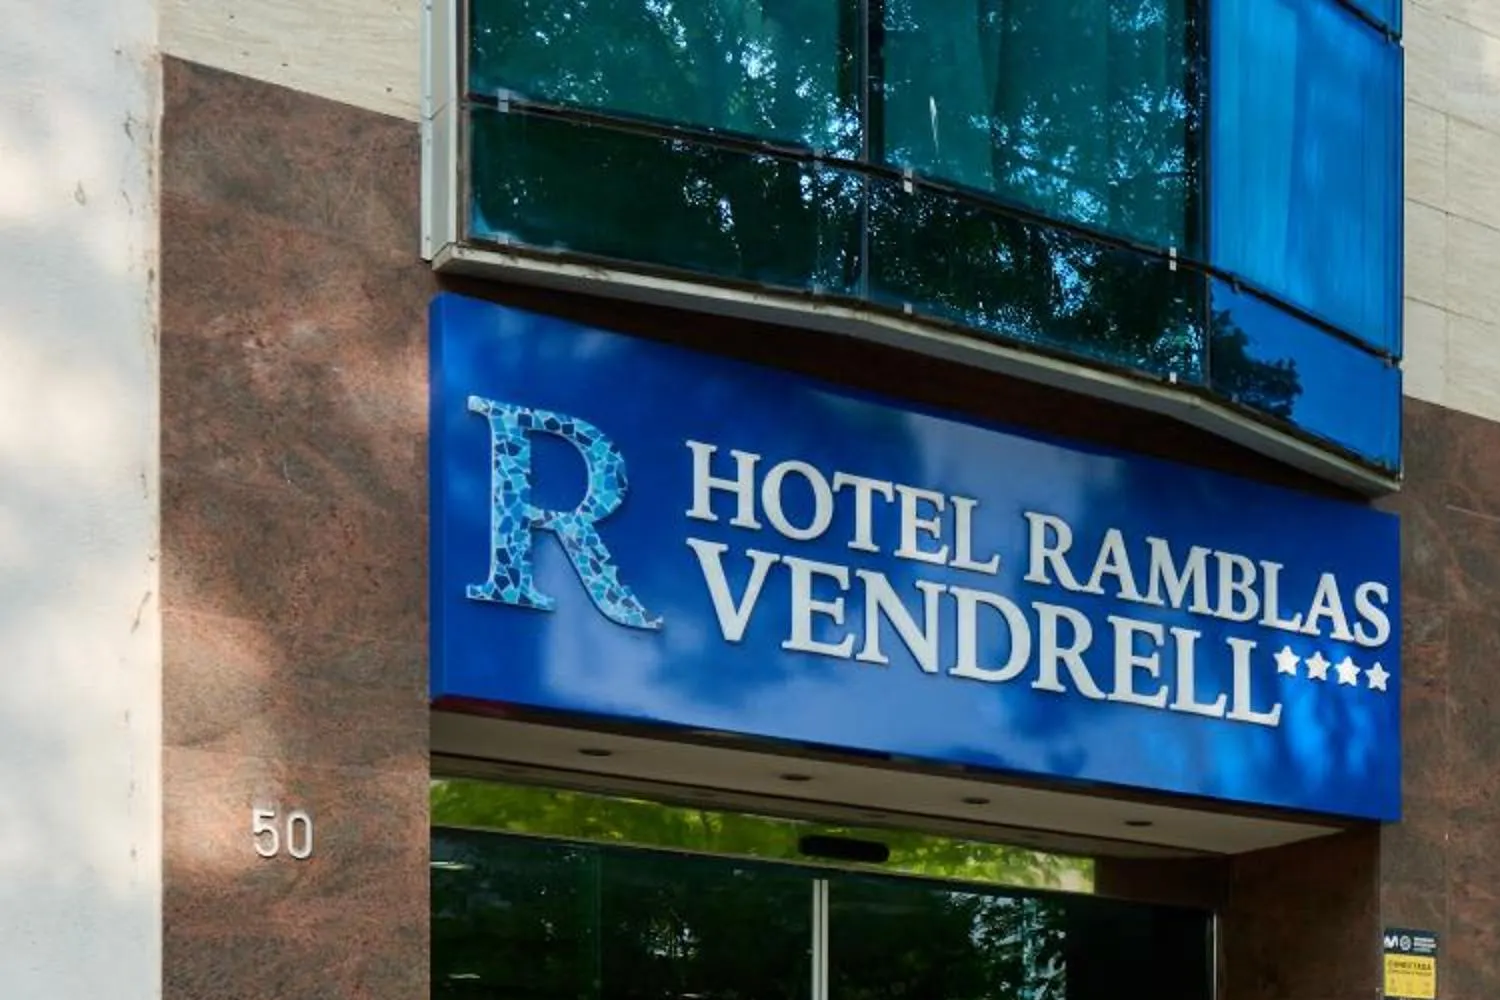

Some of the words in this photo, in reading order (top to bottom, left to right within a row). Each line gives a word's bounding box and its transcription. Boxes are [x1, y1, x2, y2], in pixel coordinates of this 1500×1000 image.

[465, 395, 664, 631] R
[686, 439, 1001, 576] HOTEL
[1022, 512, 1391, 648] RAMBLAS
[685, 536, 1284, 727] VENDRELL
[252, 807, 313, 860] 50
